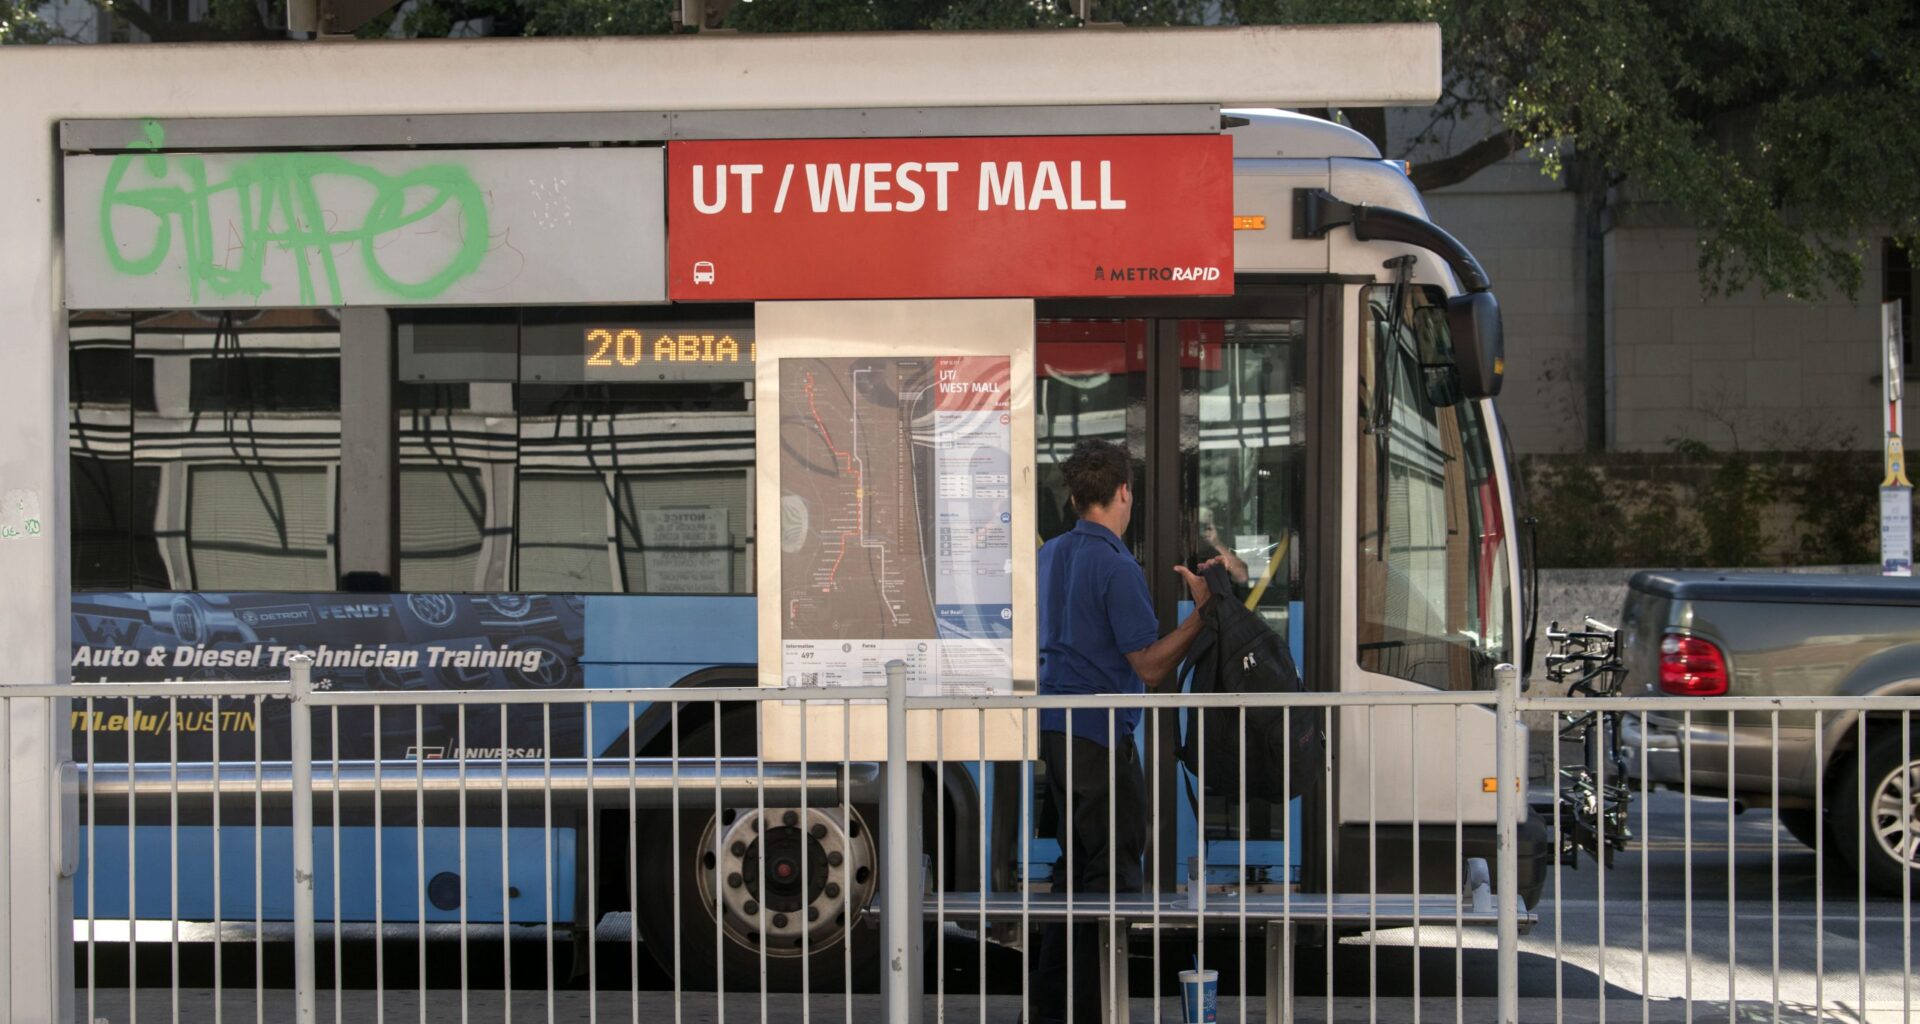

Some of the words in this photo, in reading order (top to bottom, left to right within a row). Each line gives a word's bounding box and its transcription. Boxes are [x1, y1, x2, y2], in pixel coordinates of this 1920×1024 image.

[692, 164, 764, 214] UT
[804, 162, 959, 213] WEST
[977, 160, 1127, 212] MALL
[1110, 266, 1221, 282] METRORAPID
[587, 329, 642, 366] 20
[654, 335, 739, 361] ABIA
[939, 382, 969, 393] WEST
[971, 382, 1001, 393] MALL
[259, 609, 310, 622] DETROIT
[316, 603, 393, 619] FENDT
[71, 645, 140, 667] Auto
[145, 645, 169, 667] &
[172, 643, 263, 667] Diesel
[426, 643, 543, 673] Training
[801, 651, 815, 659] 497
